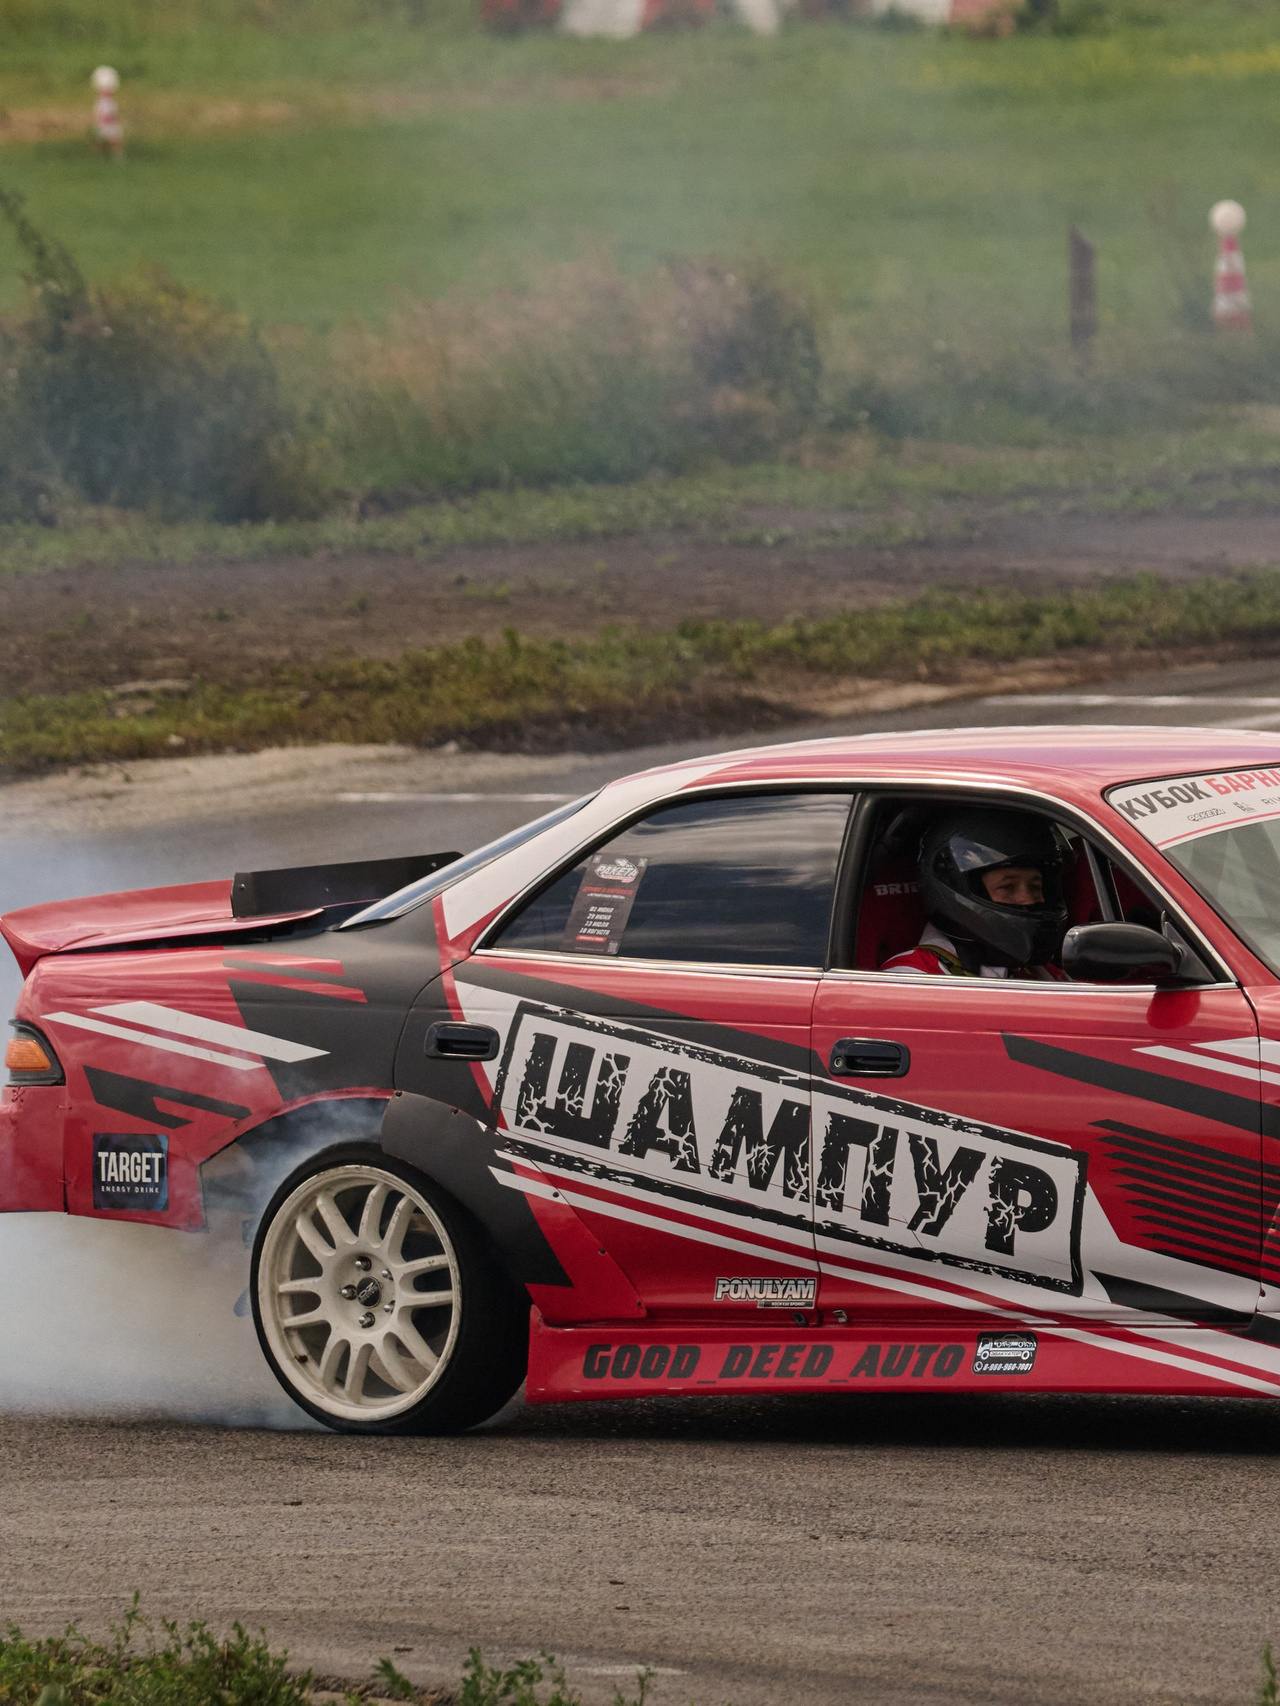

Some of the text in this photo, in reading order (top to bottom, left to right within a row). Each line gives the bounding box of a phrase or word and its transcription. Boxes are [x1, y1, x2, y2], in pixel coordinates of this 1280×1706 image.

[1116, 781, 1213, 821] КУБОК
[597, 864, 639, 878] РАКЕТА
[515, 1031, 1059, 1256] ШАМПУР
[98, 1151, 164, 1183] TARGET
[101, 1185, 160, 1194] ENERGY DRINK
[715, 1278, 816, 1300] PONULYAM
